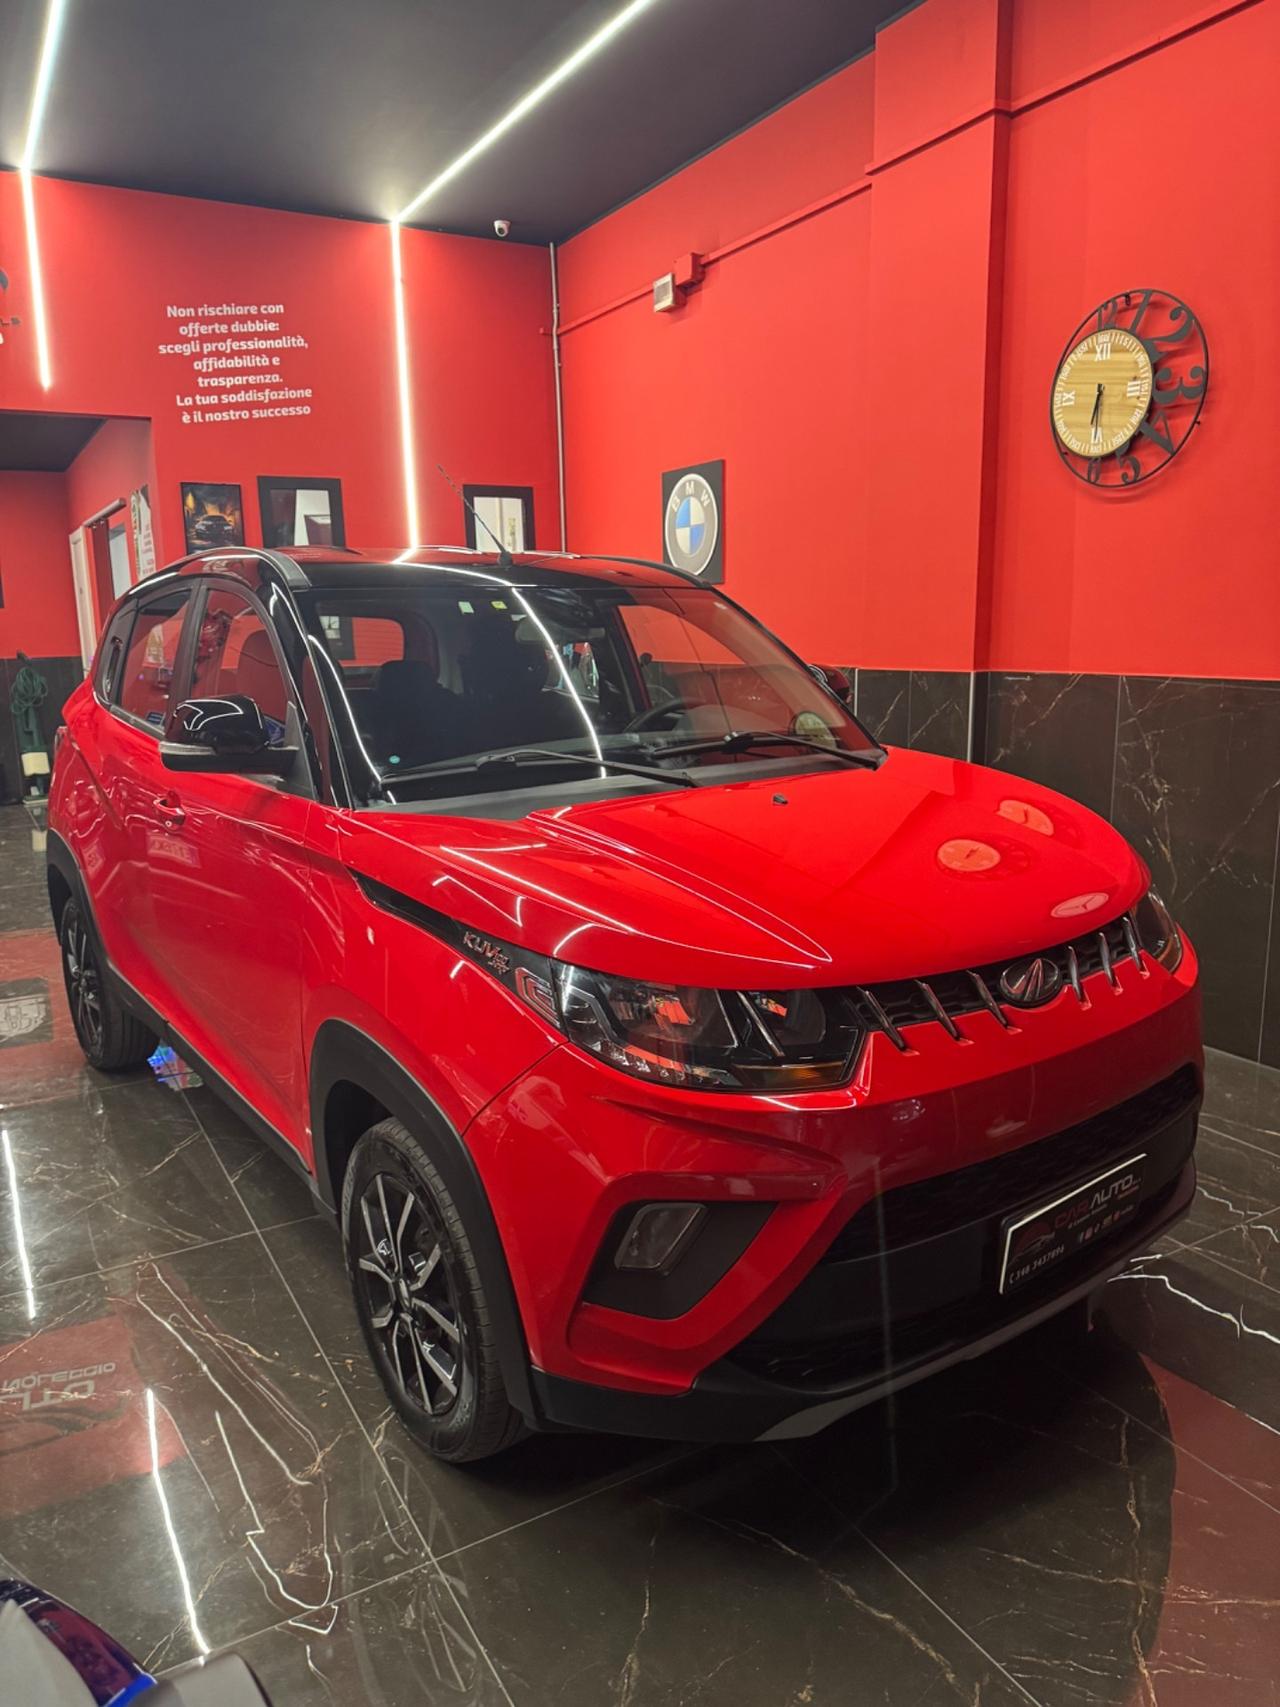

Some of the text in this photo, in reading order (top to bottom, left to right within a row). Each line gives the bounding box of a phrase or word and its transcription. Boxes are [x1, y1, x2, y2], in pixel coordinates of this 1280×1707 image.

[167, 303, 284, 318] Non rischiare con
[179, 319, 280, 338] offerte dubbie:
[158, 335, 309, 355] scegli professionalità,
[1095, 343, 1111, 362] XII
[193, 354, 281, 372] affidabilità e
[197, 373, 283, 388] trasparenza.
[1127, 380, 1140, 397] III
[1152, 366, 1205, 405] 3
[176, 387, 312, 406] La tua soddisfazione
[182, 405, 311, 424] è il nostro successo
[671, 480, 711, 513] BMW
